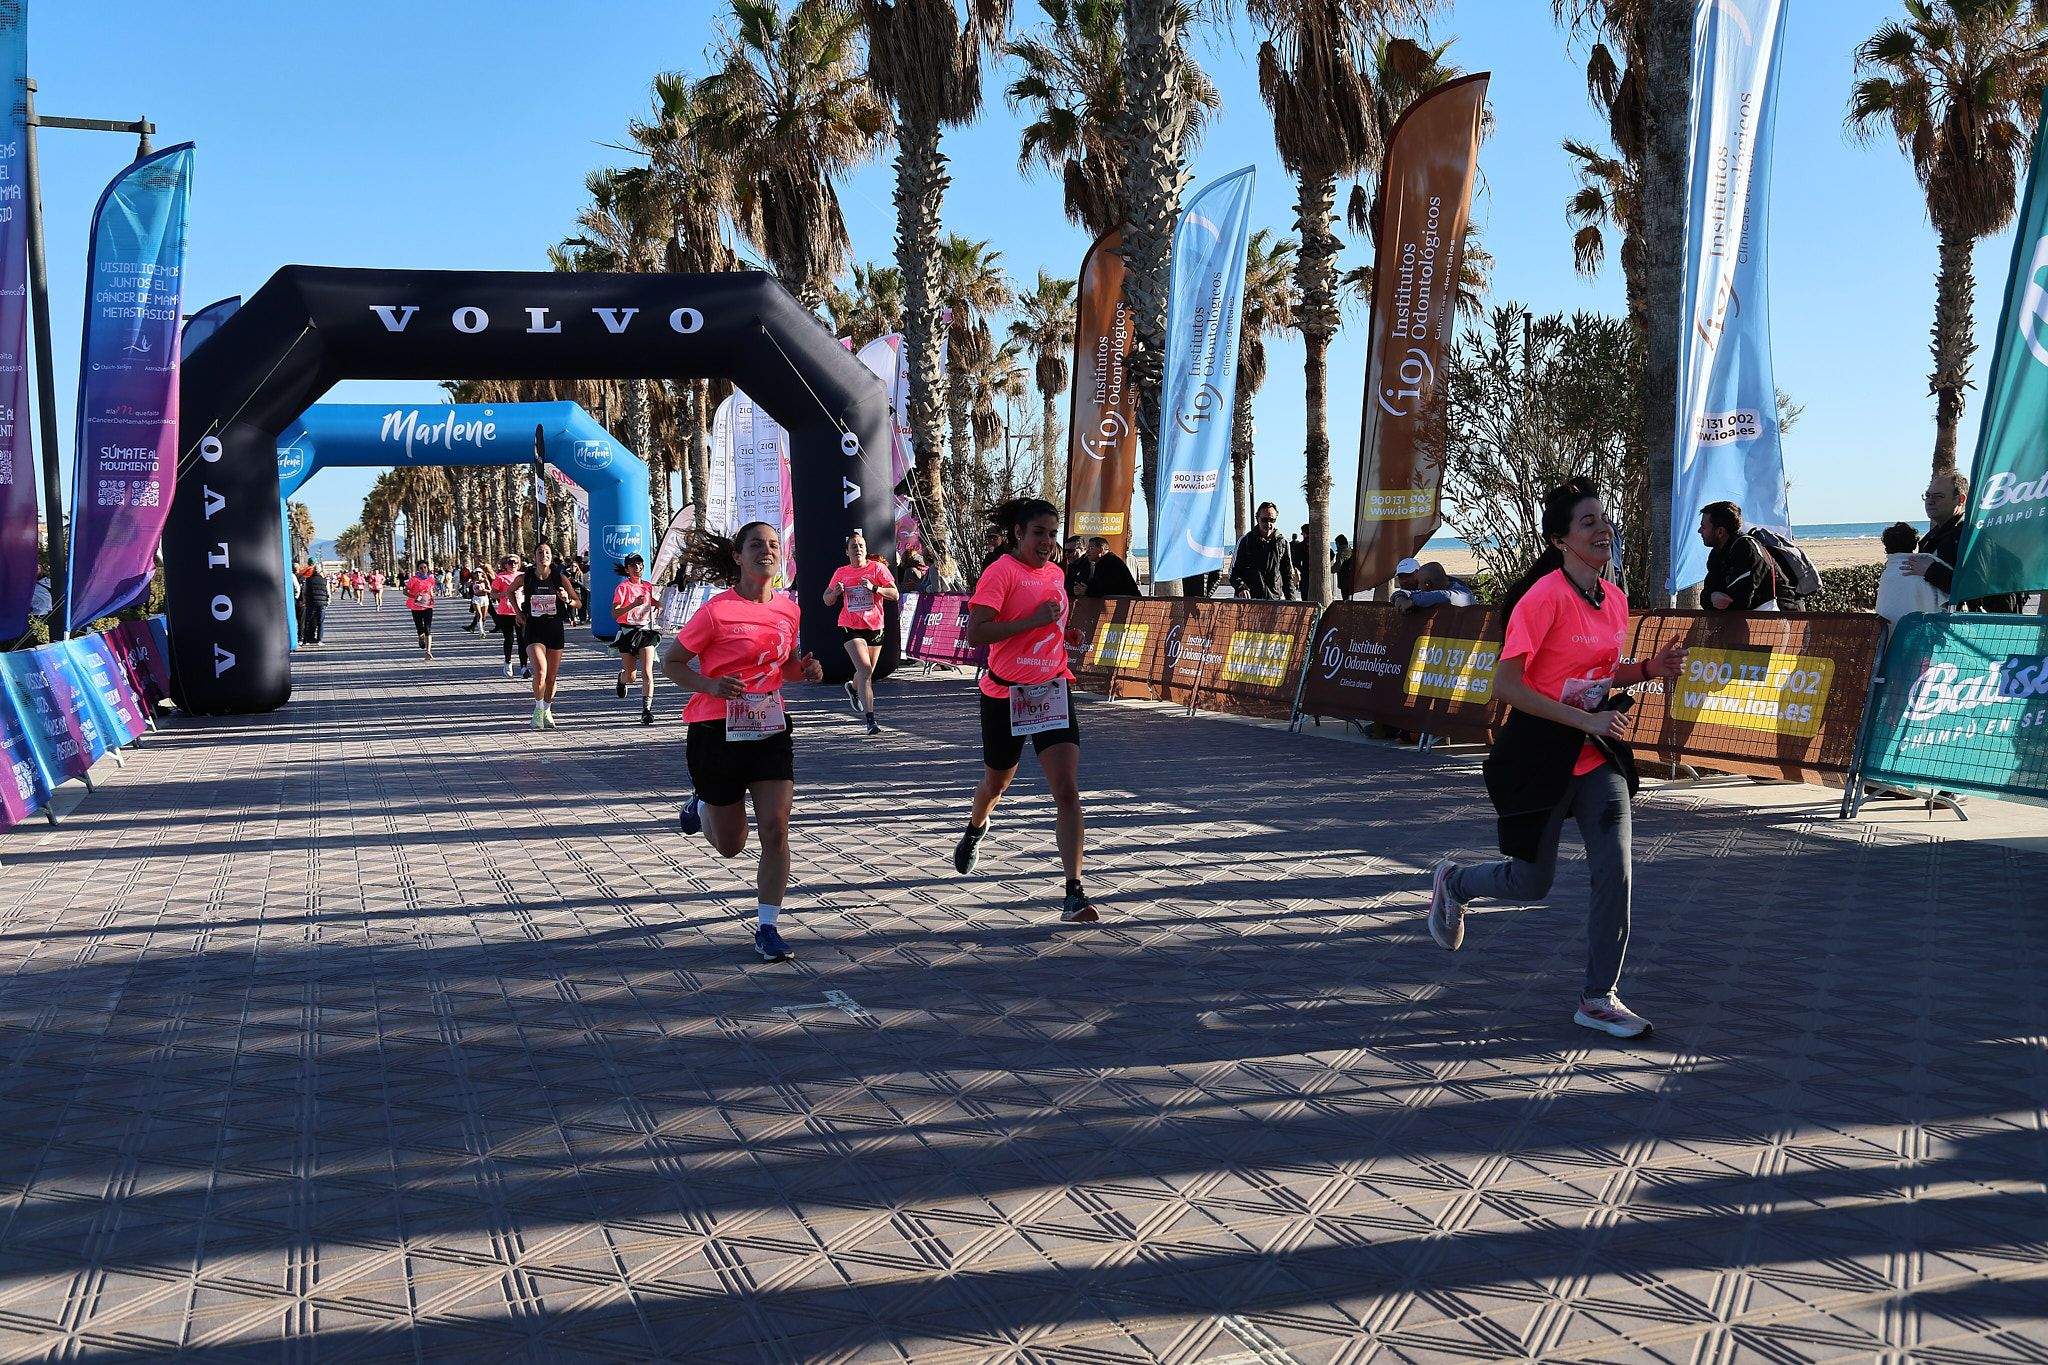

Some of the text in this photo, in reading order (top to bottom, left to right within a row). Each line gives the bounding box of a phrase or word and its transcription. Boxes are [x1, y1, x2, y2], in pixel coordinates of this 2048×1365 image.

[1412, 195, 1441, 341] Odontológicos
[110, 277, 168, 291] JUNTOS EL
[1392, 242, 1416, 339] Institutos
[97, 289, 135, 303] CÁNCER
[138, 293, 151, 304] DE
[103, 306, 175, 320] METASTÁSICO
[369, 304, 705, 334] VOLVO
[1204, 272, 1222, 378] Odontológicos
[1188, 306, 1204, 377] Institutos
[1109, 302, 1128, 406] Odontológicos
[1093, 336, 1109, 405] Institutos
[1707, 418, 1723, 429] 131
[1728, 413, 1754, 426] 002
[381, 409, 497, 459] Marlene
[1697, 427, 1756, 441] w.ioa.es
[100, 444, 160, 460] SÚMATE AL
[577, 445, 610, 462] Marlene
[100, 461, 160, 472] MOVIMIENTO
[1174, 474, 1190, 482] 900
[1193, 474, 1204, 482] 131
[1371, 494, 1431, 505] 900 131 002
[1371, 506, 1431, 516] www.ioa.es
[1976, 507, 2033, 530] CHAMPÚ
[605, 532, 641, 550] Marlene
[200, 435, 236, 679] VOLVO
[1348, 639, 1387, 655] Institutos
[1344, 655, 1402, 676] Odontológicos
[1419, 647, 1496, 671] 900 131 002
[1411, 667, 1489, 693] www.ioa.es
[1689, 660, 1732, 685] 900
[1774, 668, 1822, 695] 002
[748, 711, 766, 719] 016
[1683, 690, 1813, 723] www.ioa.es
[1900, 719, 1977, 752] CHAMPÚ
[1985, 716, 2012, 735] EN
